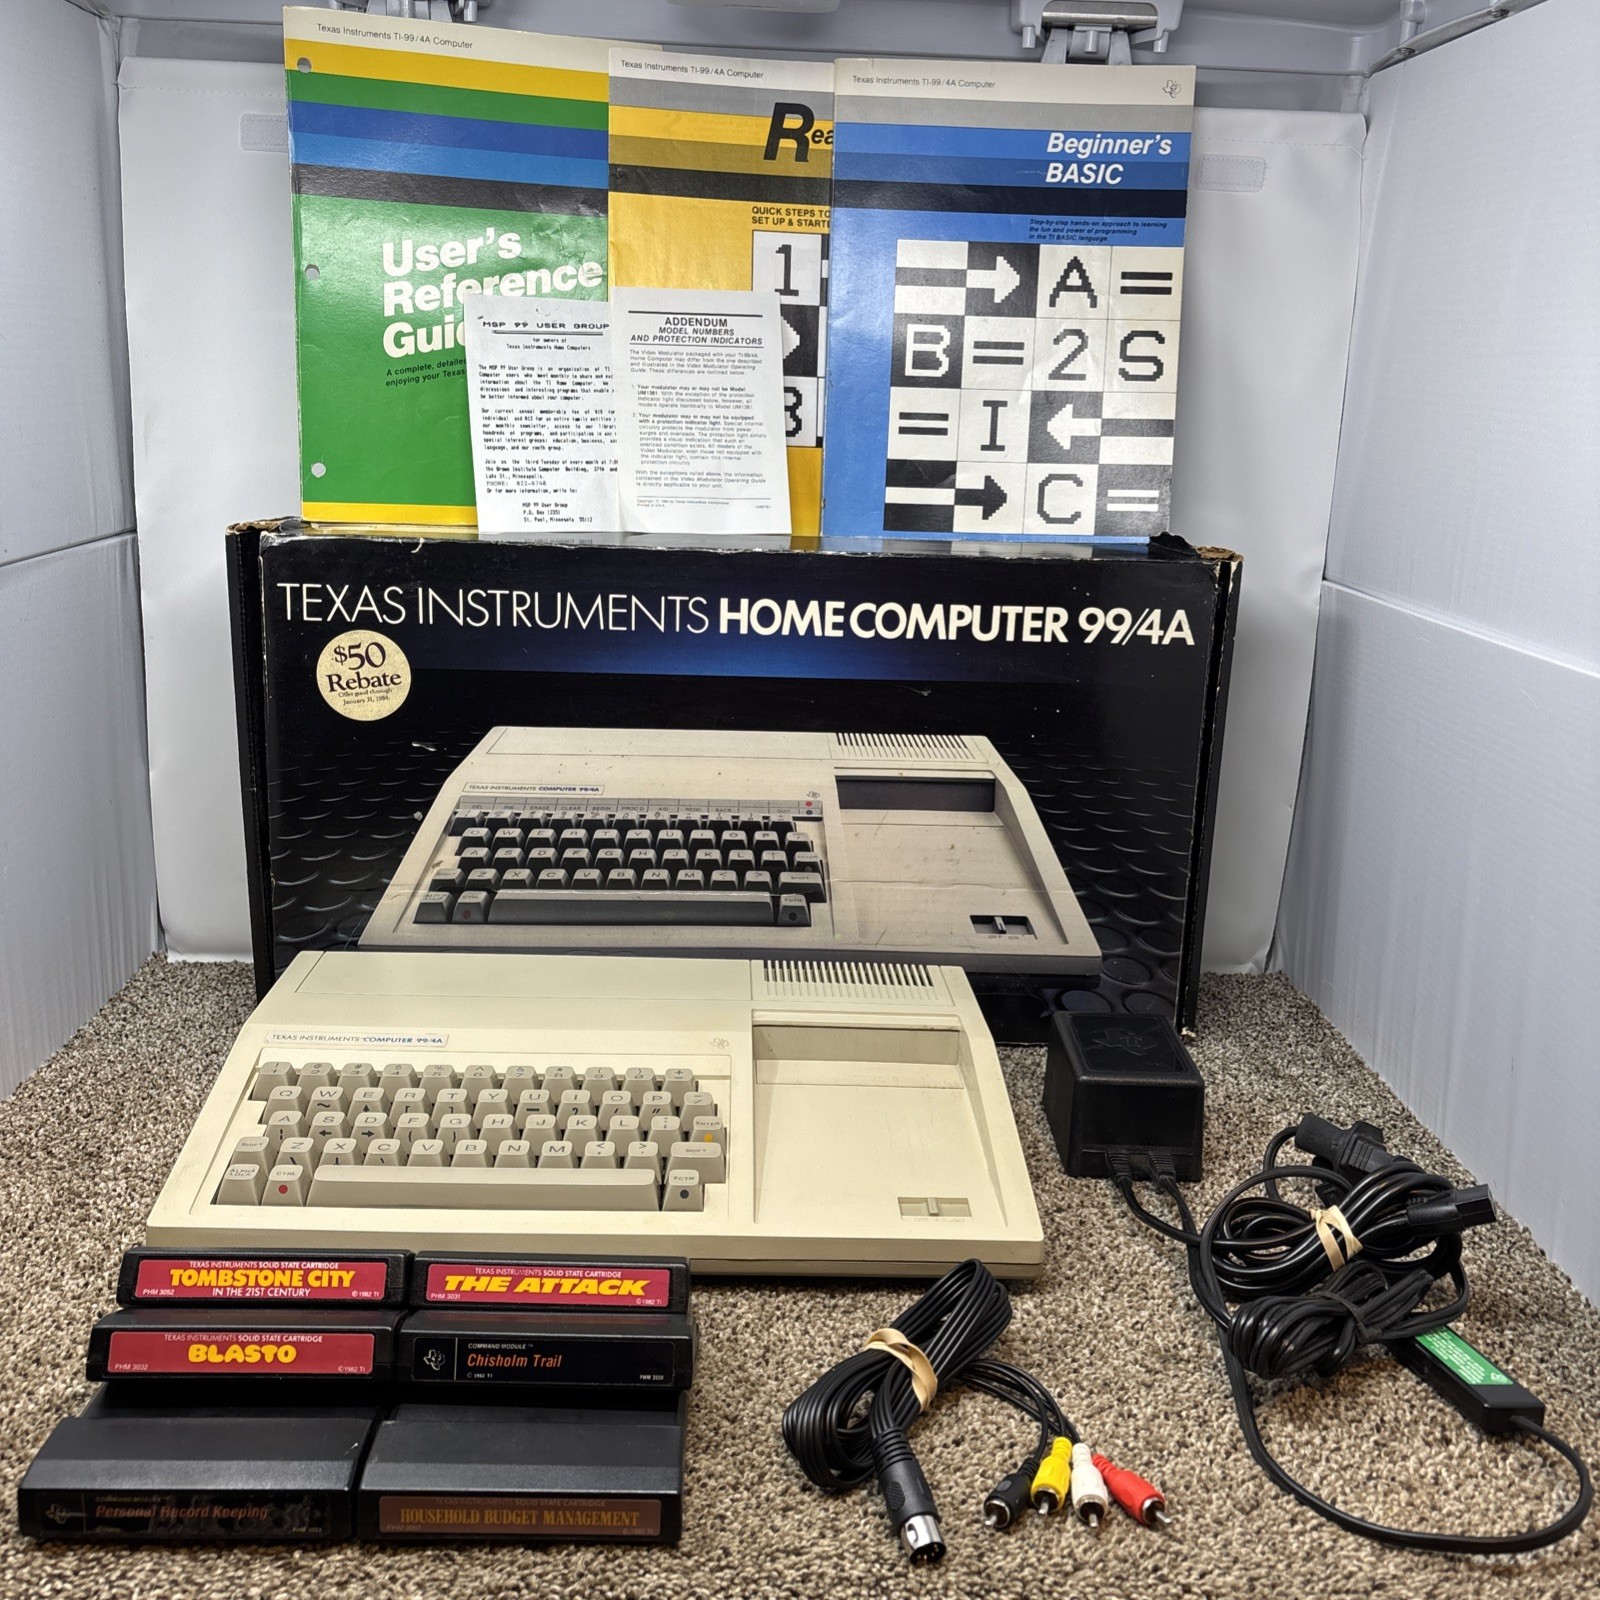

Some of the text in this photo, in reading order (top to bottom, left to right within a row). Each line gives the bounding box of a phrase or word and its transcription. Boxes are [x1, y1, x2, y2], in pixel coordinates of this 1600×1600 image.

[317, 24, 472, 49] Texas Instruments TI-99/4A Computer
[621, 60, 764, 79] Texas Instruments TI-99/4A Computer
[853, 76, 874, 84] Texas
[876, 76, 920, 86] Instruments
[958, 80, 996, 89] Computer
[1046, 132, 1172, 158] Beginner's
[1046, 162, 1124, 185] BASIC
[752, 206, 782, 216] QUICK
[786, 208, 815, 217] STEPS
[752, 216, 770, 224] SET
[382, 227, 522, 277] User's
[775, 244, 799, 296] 1
[383, 261, 604, 318] Reference
[1049, 256, 1098, 308] A
[665, 317, 728, 327] ADDENDUM
[653, 335, 708, 344] PROTECTION
[710, 337, 763, 345] INDICATORS
[904, 323, 950, 378] B
[1048, 328, 1165, 382] 2 S
[386, 369, 465, 387] enjoying your Texas
[395, 364, 434, 375] complete,
[1037, 473, 1083, 525] C
[277, 583, 1196, 646] TEXAS INSTRUMENTS HOME COMPUTER 99/4A
[334, 642, 386, 670] $50
[326, 671, 402, 692] Rebate
[170, 1269, 356, 1288] TOMBSTONE CITY
[445, 1275, 651, 1296] THE ATTACK
[212, 1288, 311, 1297] IN THE 21ST CENTURY
[188, 1344, 297, 1363] BLASTO
[467, 1353, 562, 1367] Chisholm Trail
[95, 1505, 268, 1520] Personal Record Keeping
[400, 1508, 640, 1527] HOUSEHOLD BUDGET MANAGEMENT
